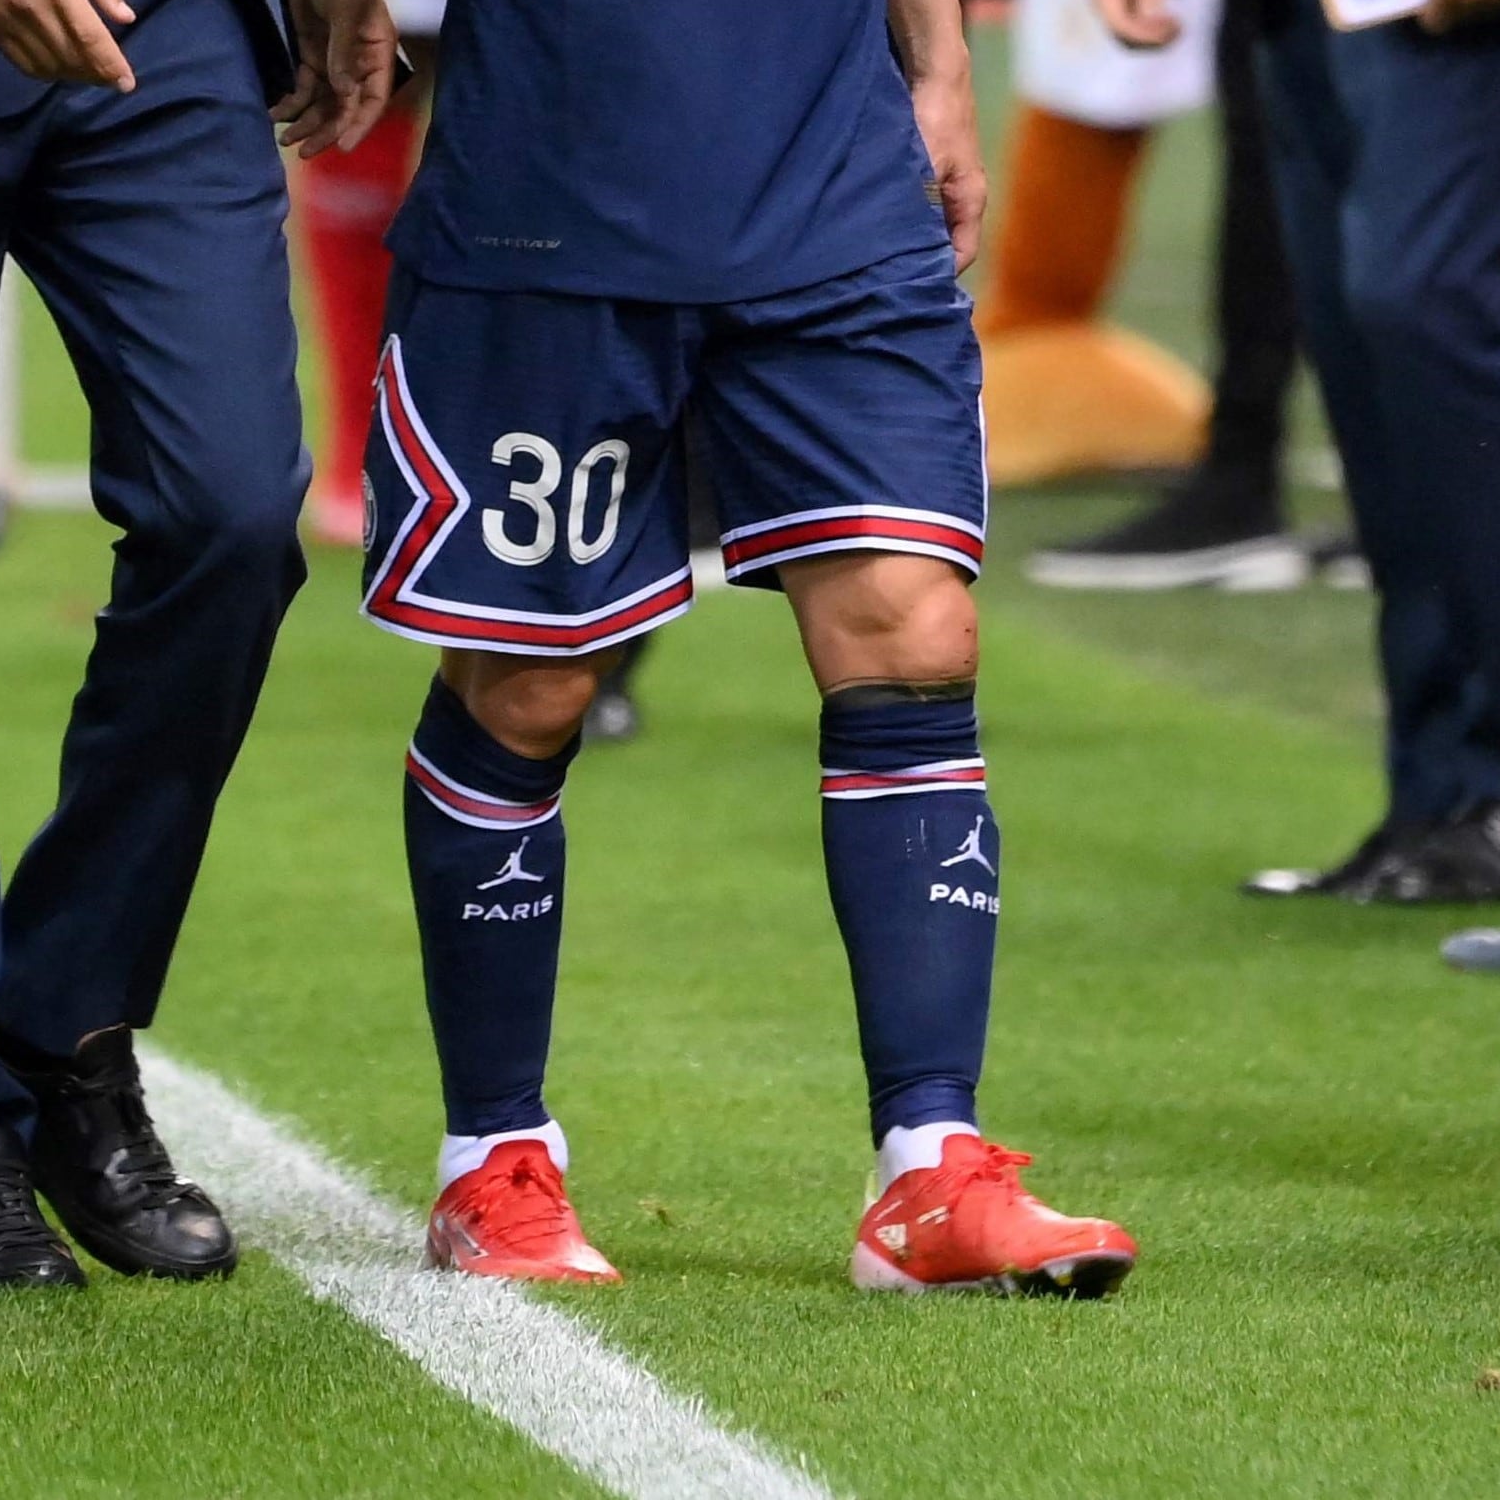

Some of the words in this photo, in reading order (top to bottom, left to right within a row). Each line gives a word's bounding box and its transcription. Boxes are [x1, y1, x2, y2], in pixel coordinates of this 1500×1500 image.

[482, 432, 630, 566] 30
[462, 894, 554, 921] PARIS
[929, 883, 1000, 914] PARIS
